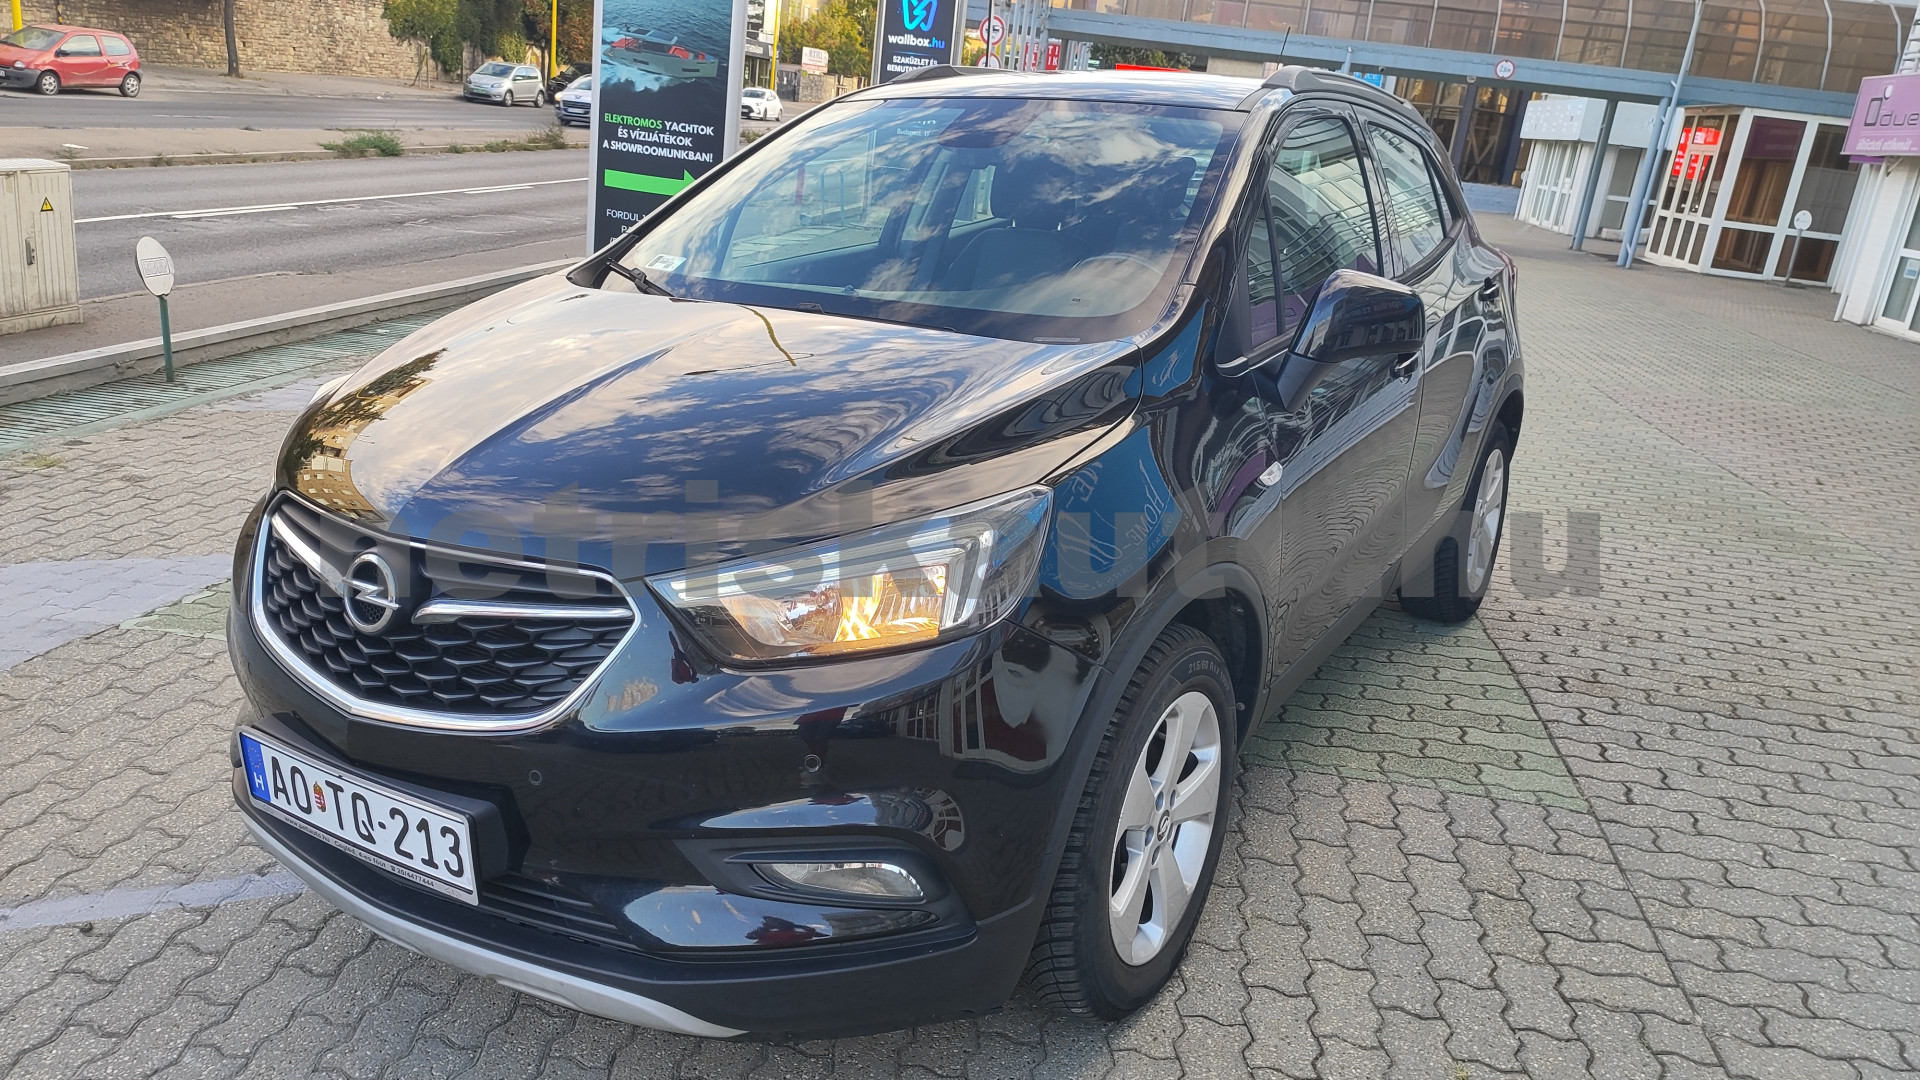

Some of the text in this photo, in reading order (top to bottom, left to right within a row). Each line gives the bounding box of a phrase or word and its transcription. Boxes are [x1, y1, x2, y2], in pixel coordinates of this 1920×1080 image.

[888, 34, 945, 49] wallbox.hu
[893, 56, 929, 66] SZAKÜZLET
[604, 113, 714, 136] ELEKTROMOS YACHTOK
[618, 126, 692, 147] ÉS VÍZIJÁTÉKOK
[603, 140, 713, 162] A SHOWROOMUNKBAN!
[254, 771, 265, 791] H
[271, 755, 466, 878] AO TQ-213
